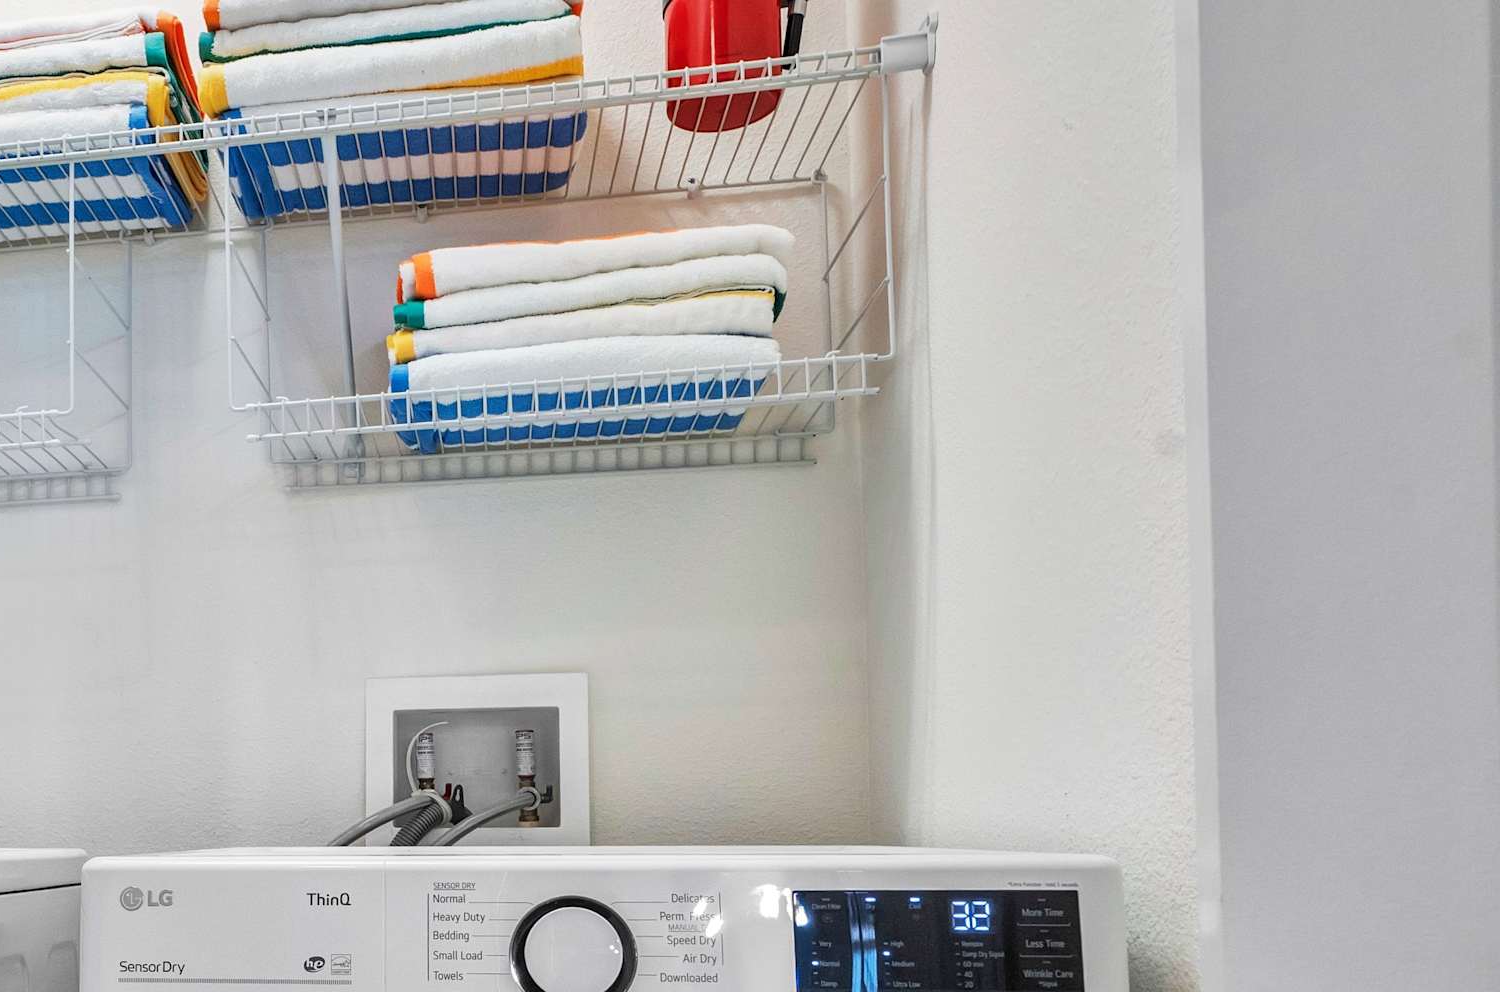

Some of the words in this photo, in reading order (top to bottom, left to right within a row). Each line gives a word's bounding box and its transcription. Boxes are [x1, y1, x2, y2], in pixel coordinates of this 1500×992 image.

[147, 889, 173, 907] LG
[306, 892, 352, 906] ThinQ
[432, 894, 466, 904] Normal
[432, 912, 461, 923] Heavy
[463, 912, 486, 924] Duty
[951, 901, 990, 931] 32
[1021, 908, 1042, 917] More
[1044, 908, 1064, 917] Time
[432, 931, 470, 942] Bedding
[667, 935, 696, 947] Speed
[699, 935, 716, 948] Dry
[1025, 939, 1044, 948] Less
[1046, 939, 1065, 948] Time
[432, 950, 458, 961] Small
[460, 950, 483, 961] Load
[682, 953, 698, 964] Air
[700, 953, 717, 966] Dry
[433, 971, 464, 981] Towels
[660, 973, 718, 983] Downloaded
[1022, 969, 1054, 978] Wrinkle
[1055, 969, 1074, 978] Care
